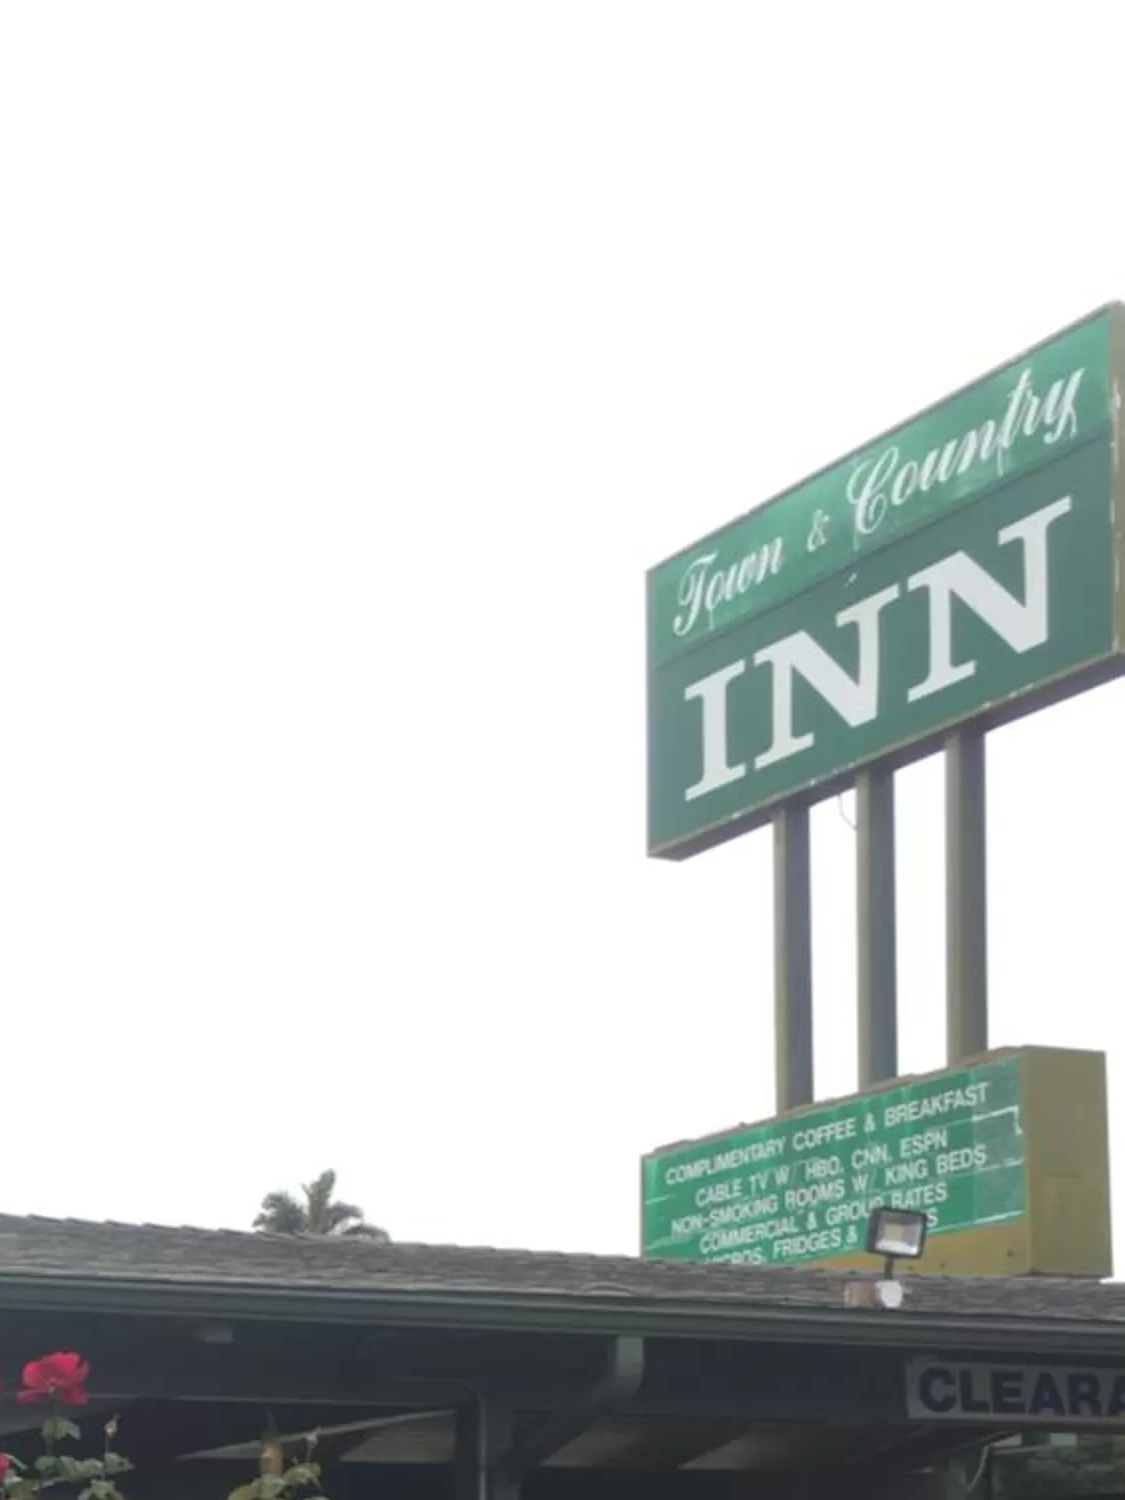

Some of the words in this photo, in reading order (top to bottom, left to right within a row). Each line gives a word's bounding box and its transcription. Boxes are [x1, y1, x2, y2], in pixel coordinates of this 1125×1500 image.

[673, 536, 783, 637] Town
[807, 508, 830, 552] &
[846, 367, 1085, 534] Country
[684, 495, 1072, 801] INN
[665, 1136, 786, 1184] COMPLIMENTARY
[792, 1117, 857, 1151] COFFEE
[863, 1112, 876, 1133] &
[884, 1082, 989, 1127] BREAKFAST
[695, 1178, 743, 1207] CABLE
[748, 1170, 769, 1196] TV
[899, 1128, 948, 1158] ESPN
[671, 1194, 779, 1238] NON-SMOKING
[784, 1179, 845, 1210] ROOMS
[885, 1159, 928, 1186] KING
[936, 1144, 987, 1175] BEDS
[699, 1216, 799, 1253] COMMERCIAL
[806, 1211, 818, 1232] &
[890, 1181, 948, 1210] RATES
[773, 1227, 841, 1258] FRIDGES
[846, 1225, 858, 1244] &
